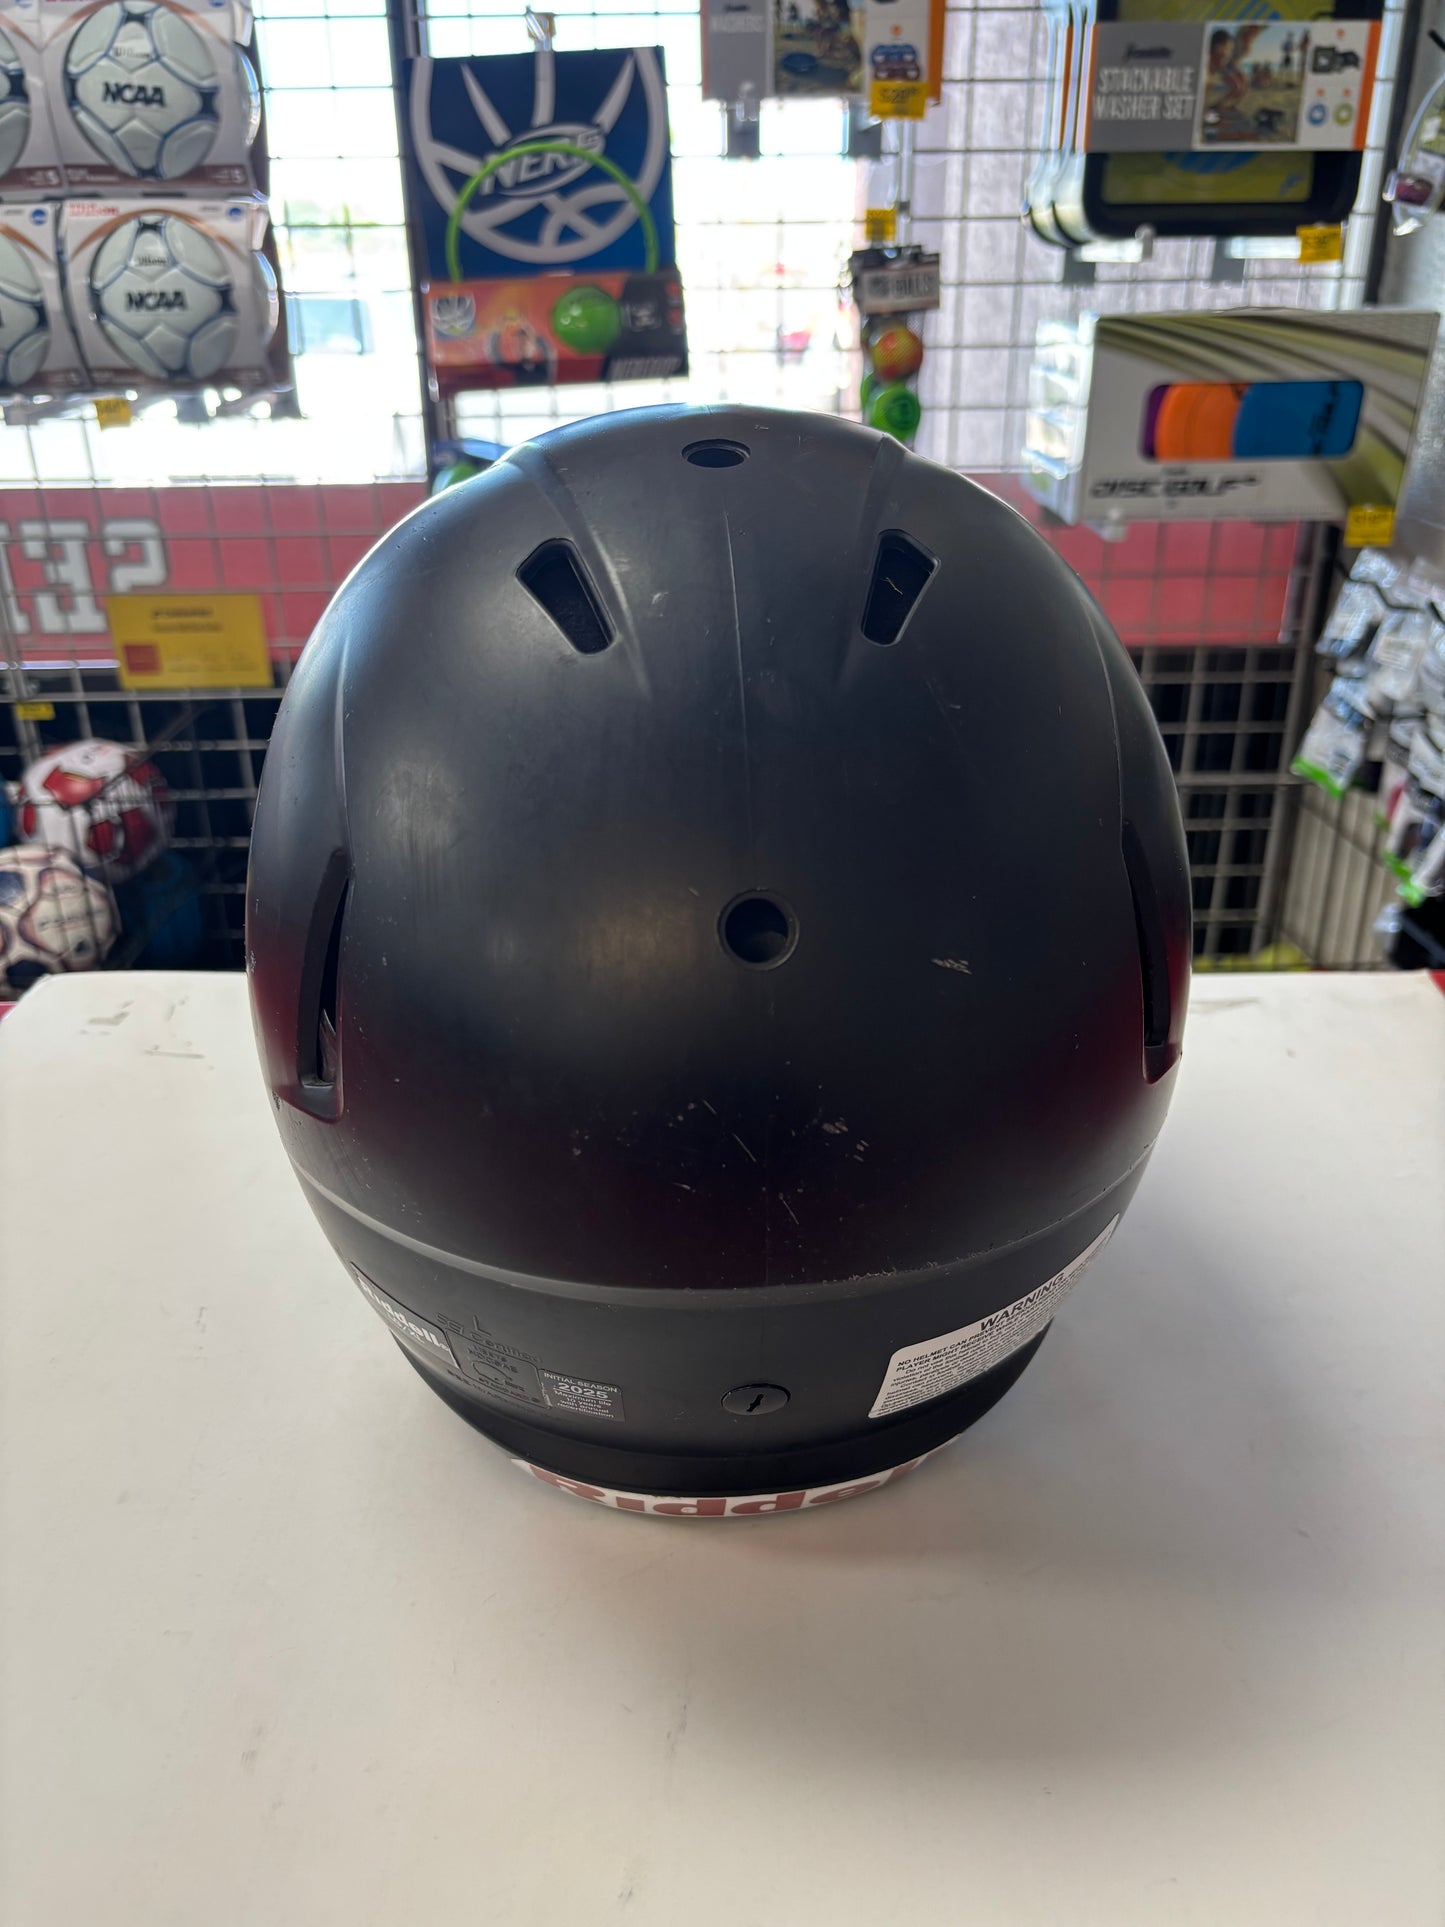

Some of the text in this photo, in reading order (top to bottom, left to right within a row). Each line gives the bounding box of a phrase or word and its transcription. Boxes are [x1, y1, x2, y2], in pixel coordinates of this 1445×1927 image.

[1098, 65, 1196, 95] STACKABLE
[102, 82, 167, 107] NCAA
[1092, 96, 1195, 121] WASHER SET
[478, 129, 602, 196] NERF
[125, 291, 188, 313] NCAA
[980, 1271, 1065, 1332] WARNING
[895, 1358, 930, 1373] PLAYER
[932, 1345, 960, 1361] MIGHT
[897, 1359, 911, 1367] NO
[912, 1346, 948, 1362] HELMET
[949, 1338, 968, 1349] CAN
[543, 1372, 618, 1393] INITIAL SEASON
[558, 1382, 609, 1399] 2025
[528, 1451, 946, 1516] Riddel
